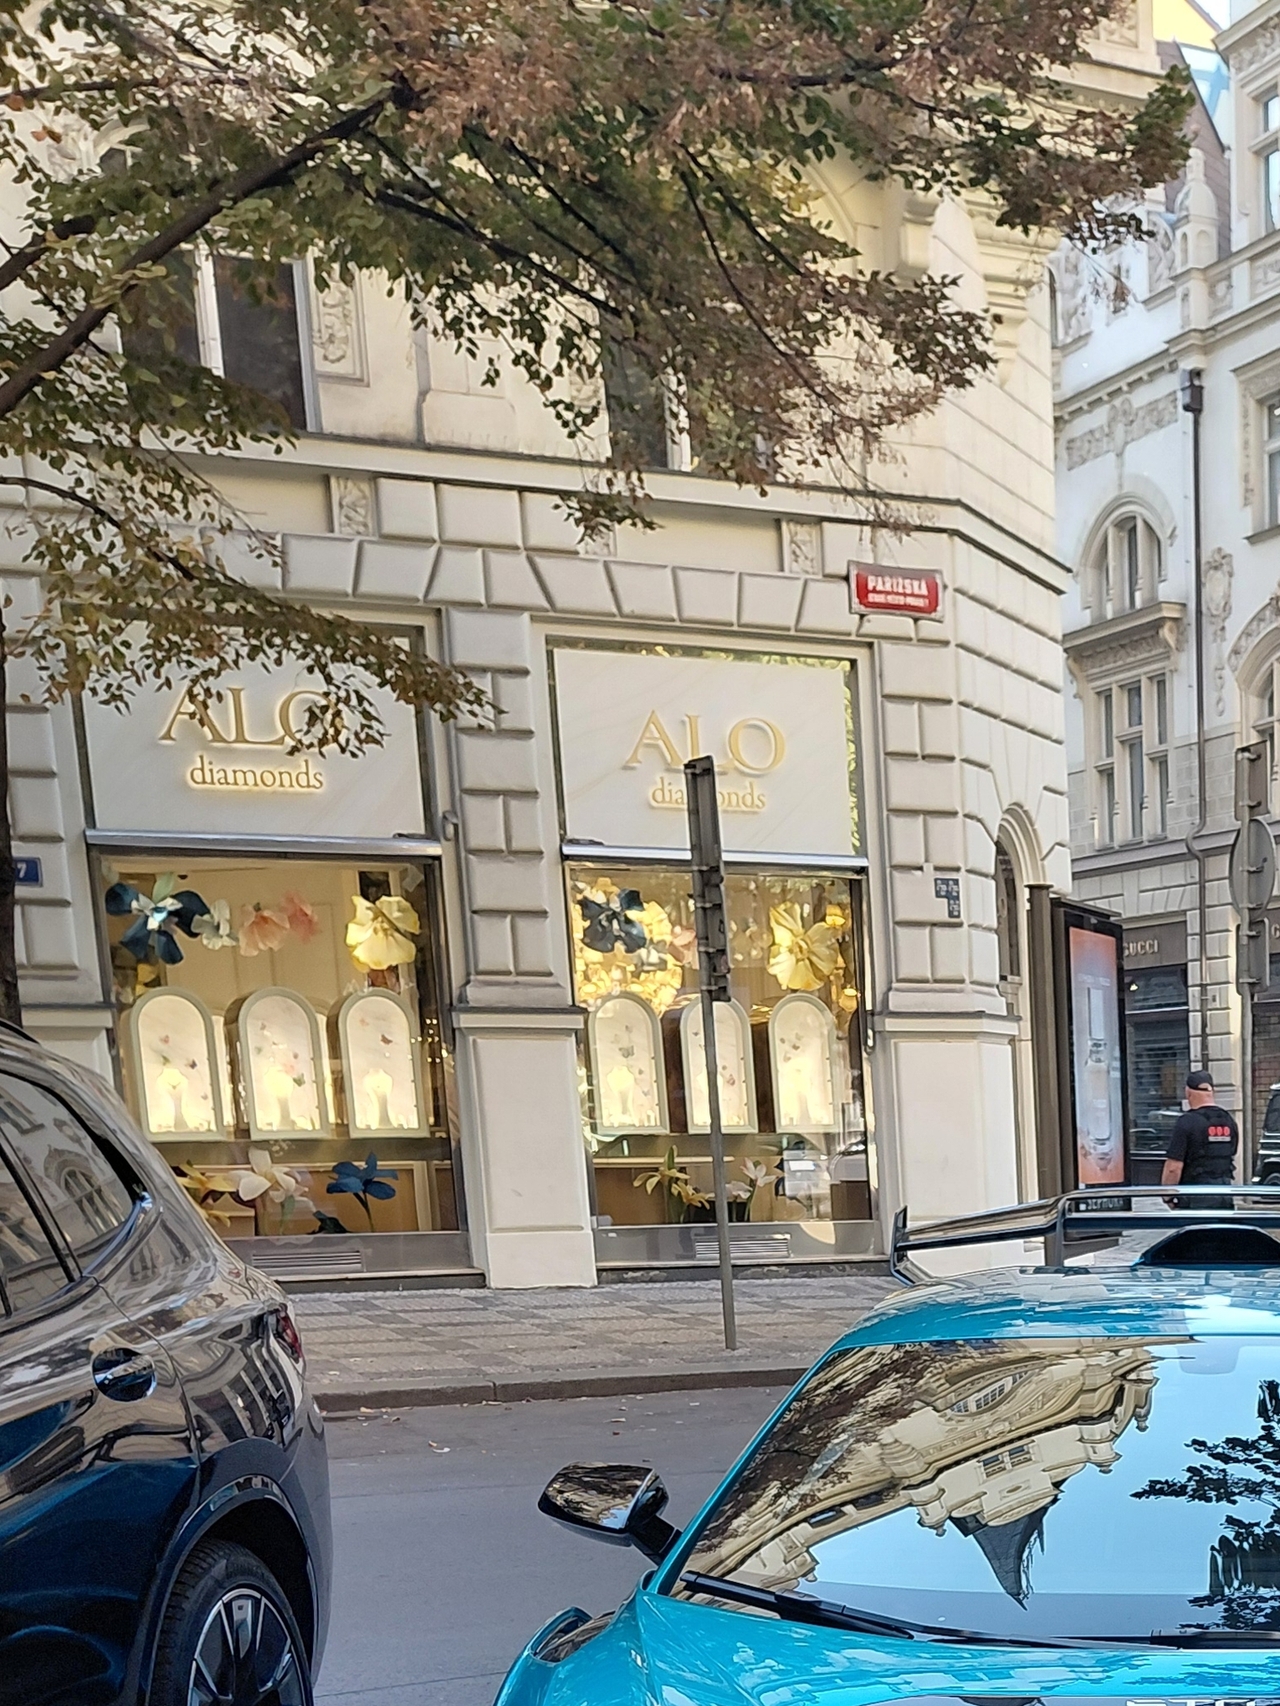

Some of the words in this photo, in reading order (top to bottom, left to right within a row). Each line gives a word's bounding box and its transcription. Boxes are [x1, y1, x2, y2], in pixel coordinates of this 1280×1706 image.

[625, 709, 786, 773] ALO
[189, 754, 324, 790] diamonds
[651, 776, 767, 810] diaonds
